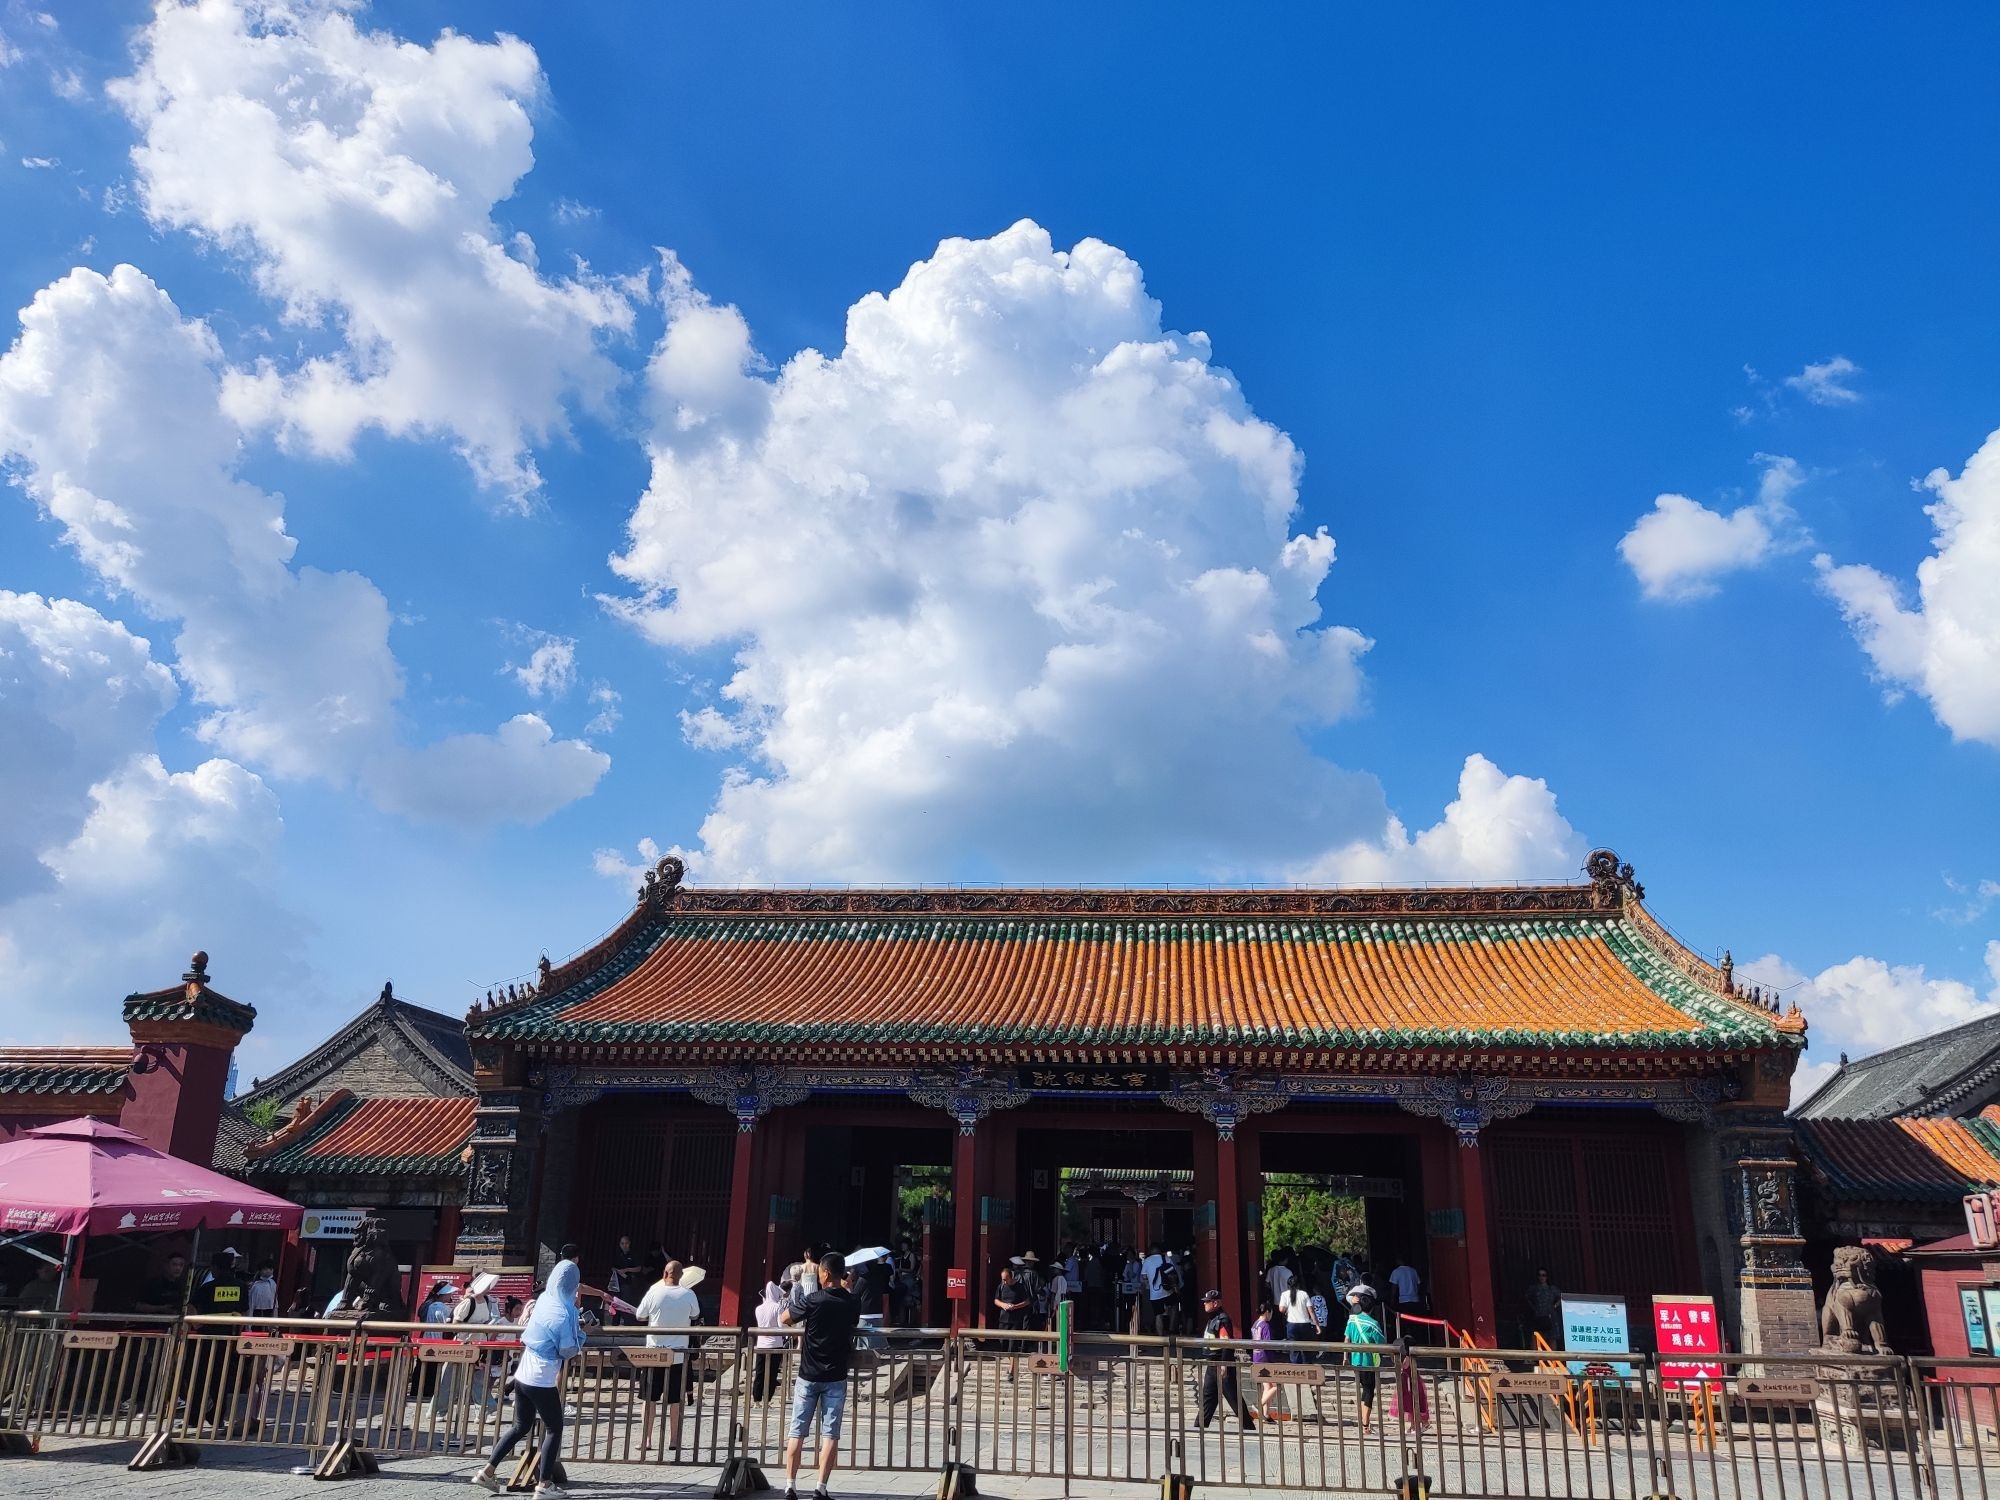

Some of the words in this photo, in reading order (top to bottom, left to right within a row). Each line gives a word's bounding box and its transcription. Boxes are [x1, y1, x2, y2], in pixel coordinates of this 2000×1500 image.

[1032, 1070, 1147, 1087] 沈阳故宫
[1660, 1310, 1681, 1322] 军人
[1688, 1310, 1711, 1323] 警察
[1571, 1335, 1622, 1344] 文明旅游在心间
[1672, 1333, 1706, 1347] 残疾人
